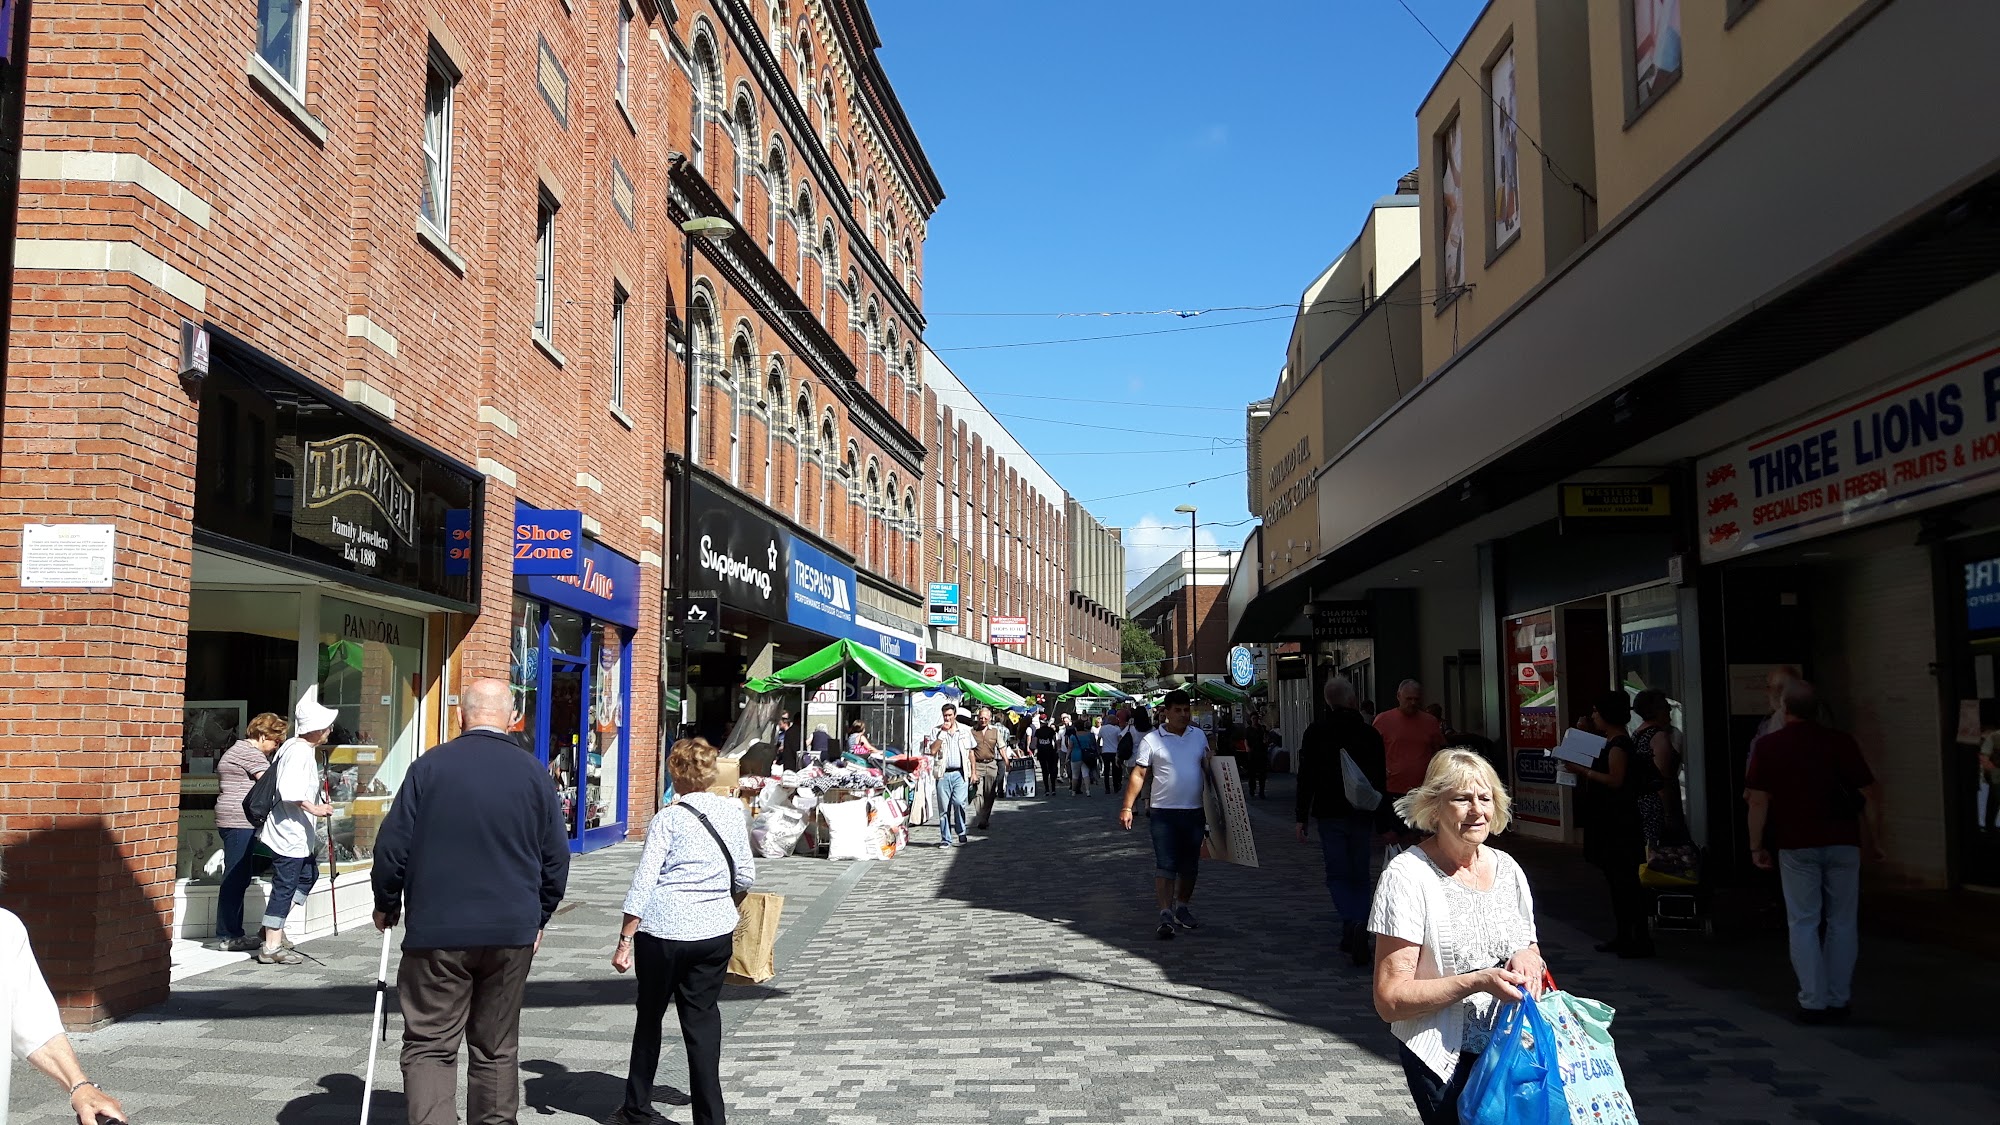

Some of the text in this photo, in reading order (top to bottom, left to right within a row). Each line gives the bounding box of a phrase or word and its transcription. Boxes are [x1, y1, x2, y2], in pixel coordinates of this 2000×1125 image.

[1749, 429, 1839, 498] THREE
[1853, 383, 1963, 465] LIONS
[354, 441, 409, 533] BAKER
[1753, 432, 2000, 525] SPECIALISTS IN FRESH FRUITS & HO
[1584, 488, 1639, 504] WESTERN UNION
[331, 515, 389, 551] Family Jewellers
[516, 524, 572, 541] Shoe
[344, 542, 376, 568] Est. 1888
[514, 543, 573, 559] Zone
[582, 557, 613, 600] Zone
[700, 534, 773, 600] Superdrug
[795, 559, 832, 600] TRESPASS
[1321, 609, 1368, 617] CHAPMAN
[344, 613, 400, 646] PANDORA
[1314, 626, 1369, 635] OPTICIANS
[879, 633, 900, 657] WHSmith
[1519, 759, 1555, 775] SELLERS
